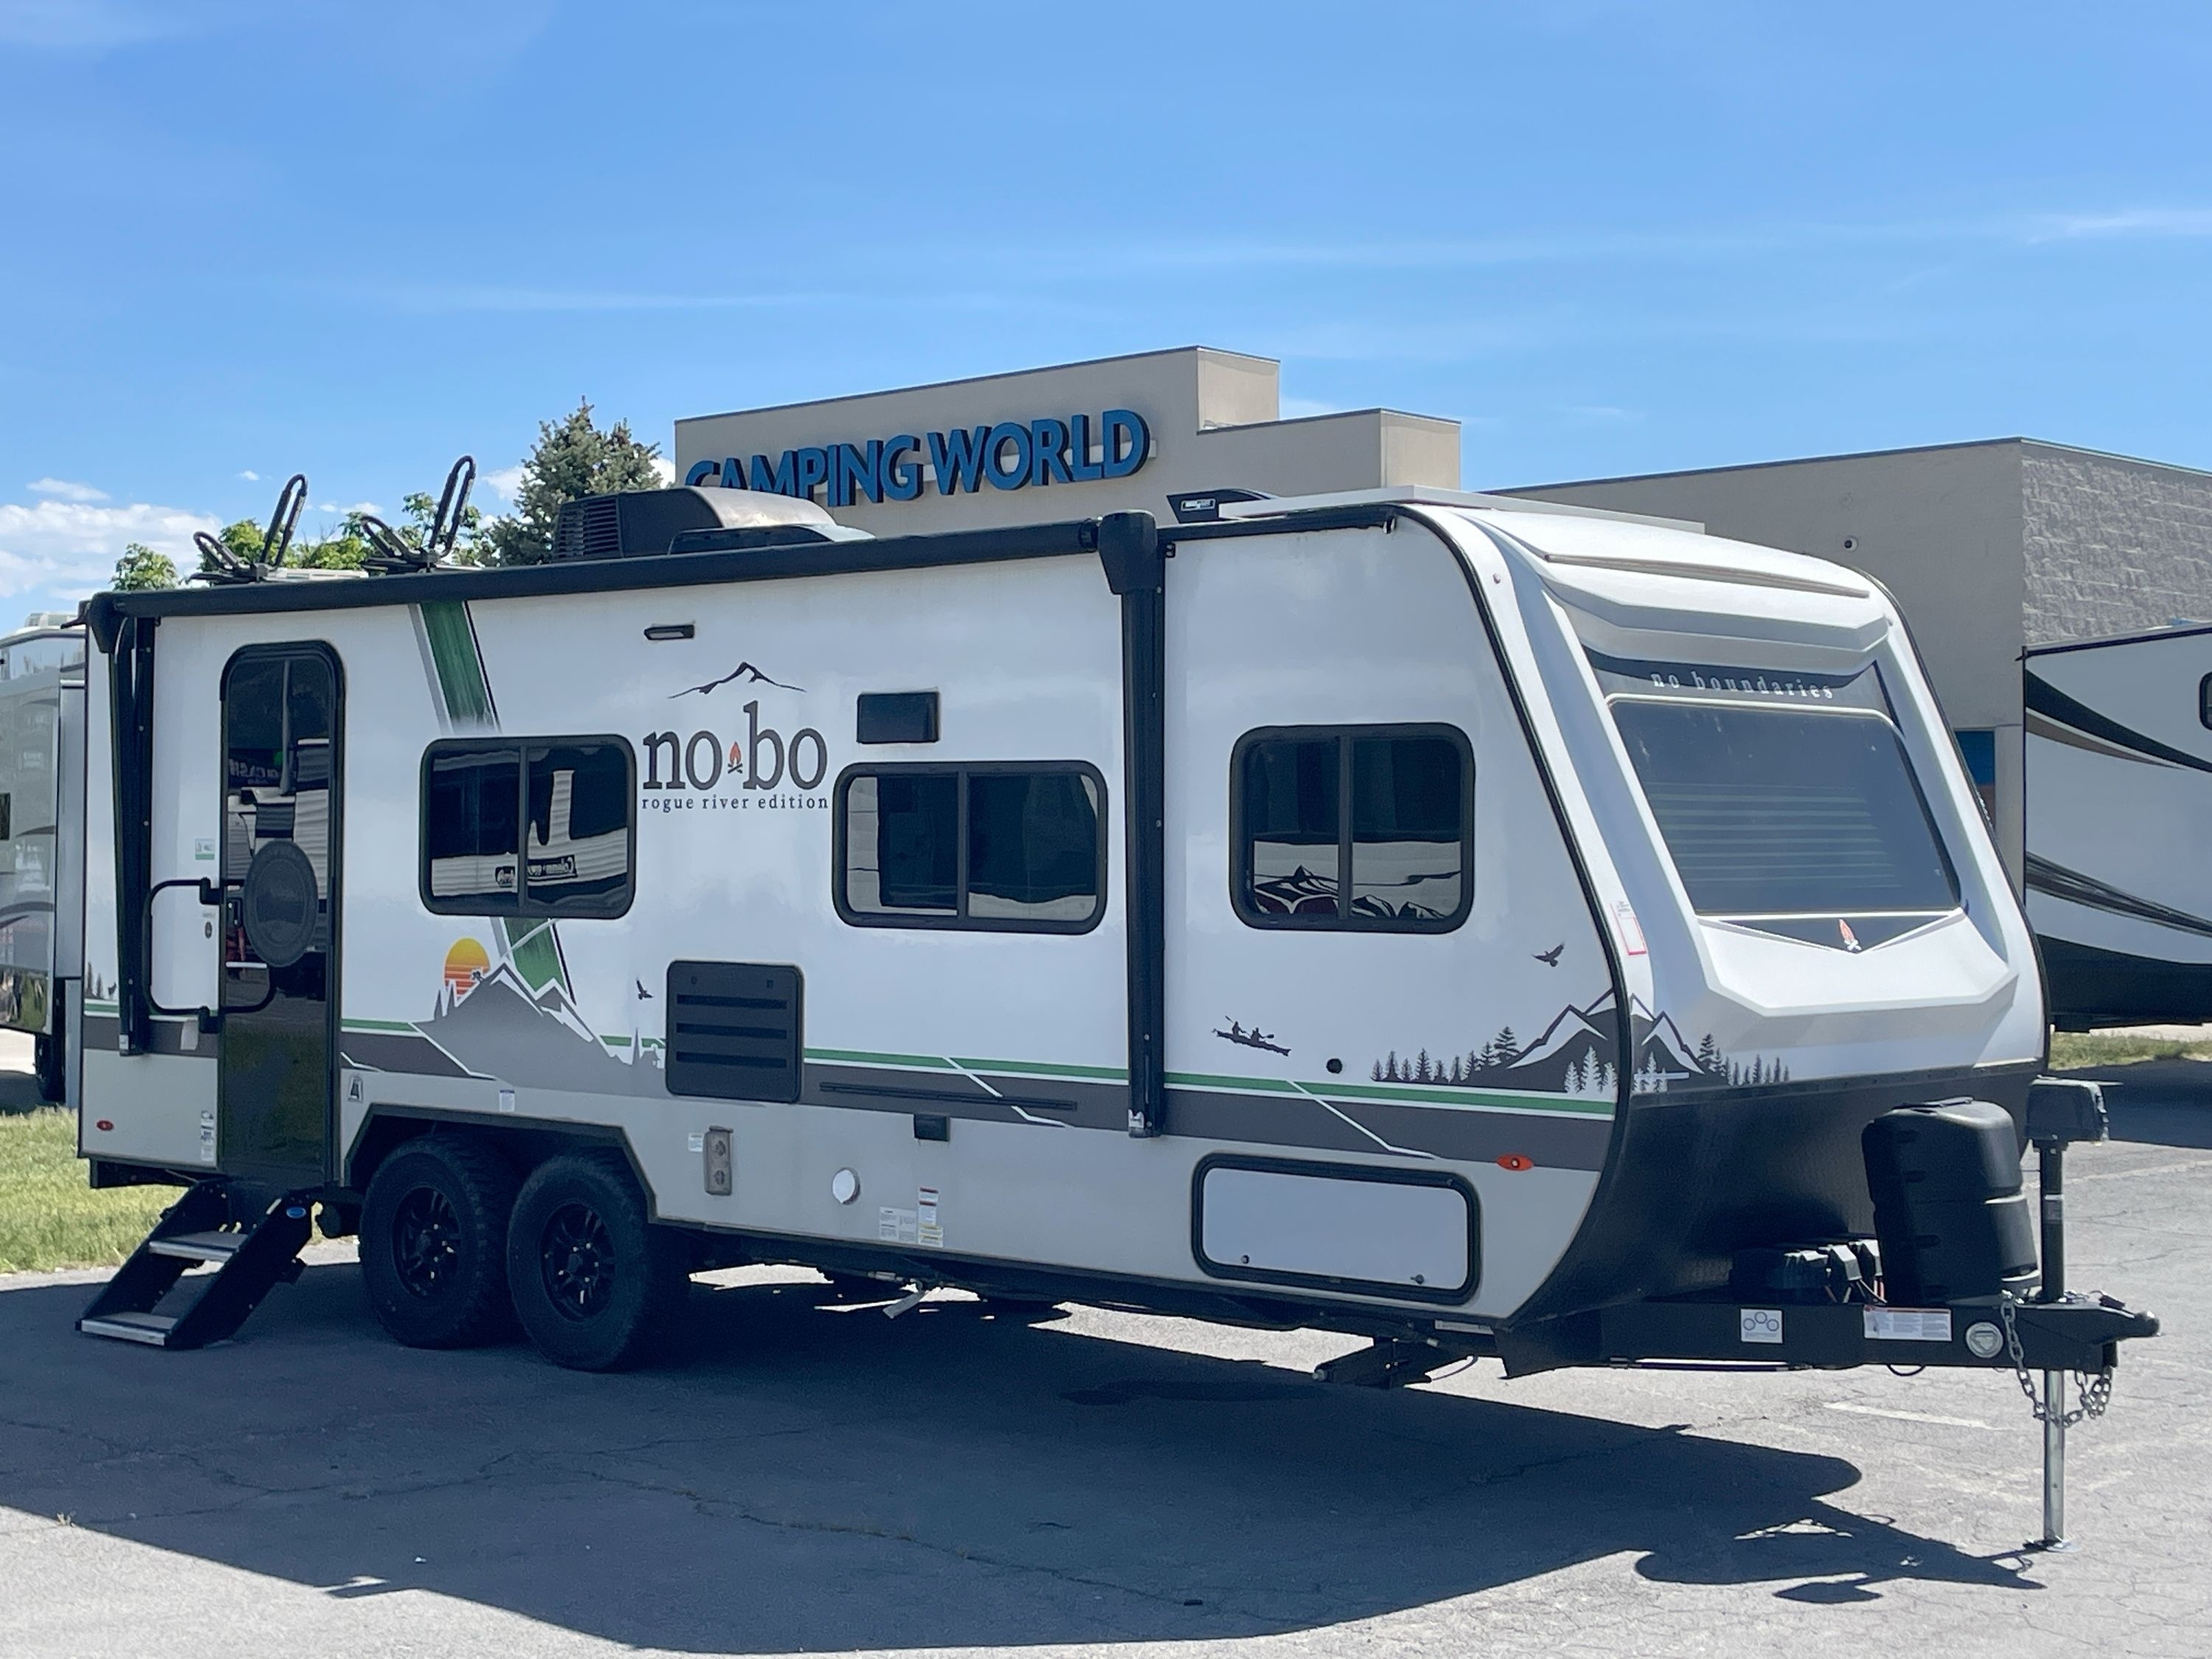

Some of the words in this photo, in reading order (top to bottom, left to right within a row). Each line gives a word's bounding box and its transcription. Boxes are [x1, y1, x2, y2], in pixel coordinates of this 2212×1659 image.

[927, 408, 1150, 496] WORLD
[1650, 672, 1680, 689] no
[1690, 670, 1833, 698] boundaries
[641, 796, 695, 813] rogue
[702, 794, 749, 809] river
[757, 793, 829, 810] edition
